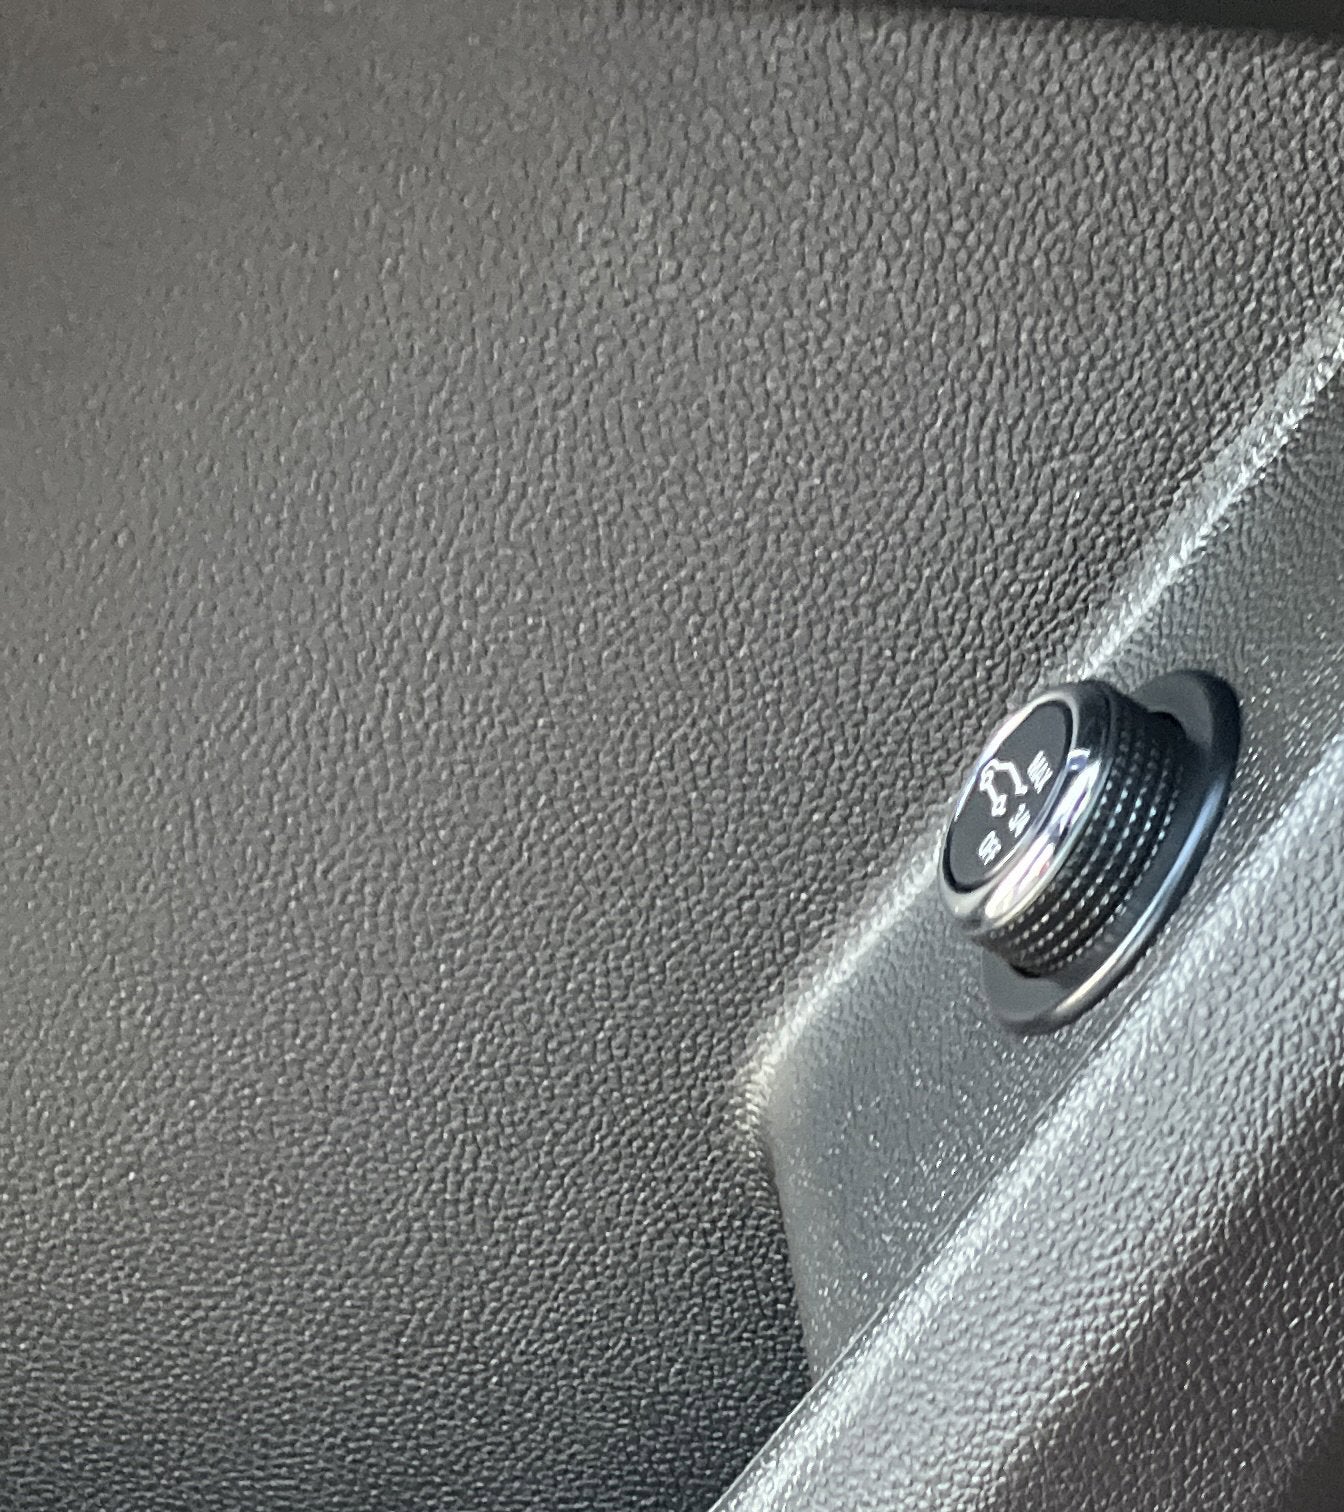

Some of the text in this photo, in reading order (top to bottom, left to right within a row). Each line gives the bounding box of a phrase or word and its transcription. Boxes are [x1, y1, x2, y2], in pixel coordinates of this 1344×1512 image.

[1026, 750, 1053, 794] MAX
[1008, 803, 1031, 838] 3/4
[978, 830, 1002, 866] OFF
